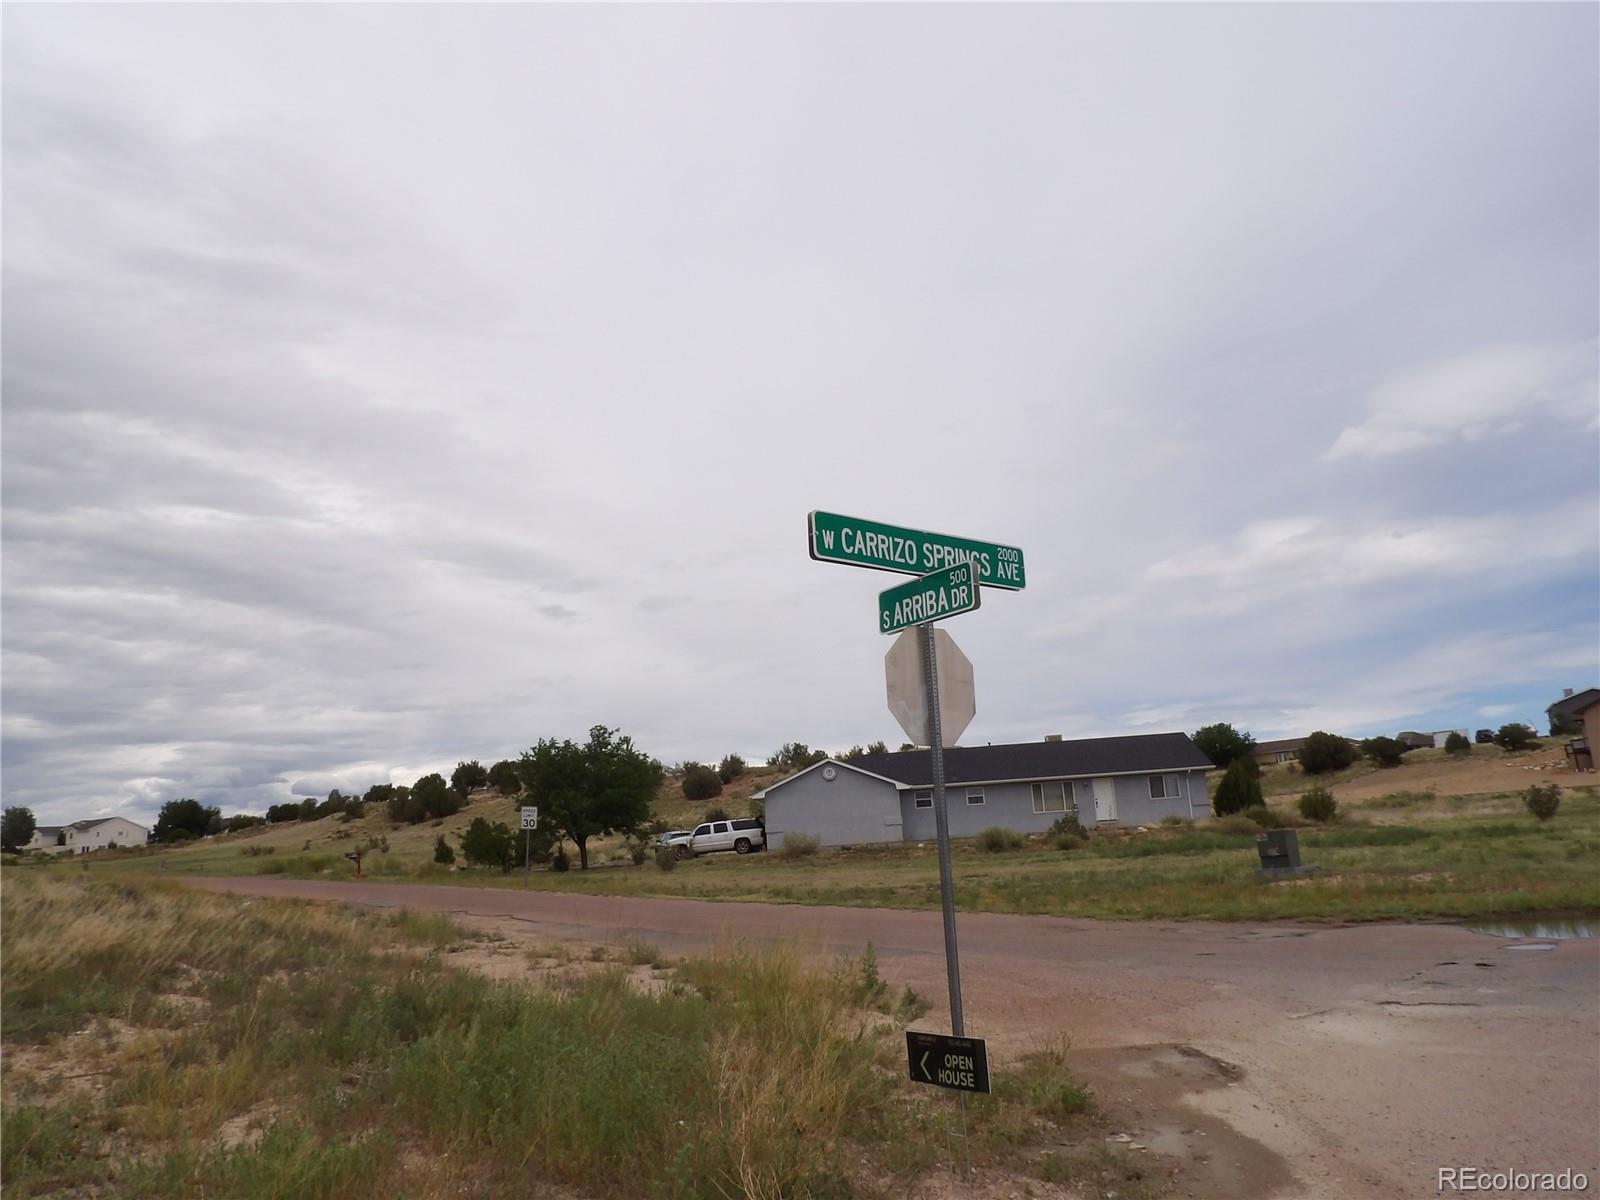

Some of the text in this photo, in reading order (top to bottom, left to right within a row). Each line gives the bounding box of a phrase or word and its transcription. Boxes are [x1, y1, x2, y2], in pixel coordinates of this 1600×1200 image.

[821, 529, 834, 550] W
[841, 527, 917, 565] CARRIZO
[997, 547, 1019, 562] 2000
[949, 567, 967, 586] 500
[996, 561, 1021, 582] AVE
[883, 585, 969, 629] S ARRIBA DR
[523, 819, 535, 828] 30
[944, 1054, 974, 1071] OPEN
[938, 1068, 975, 1088] HOUSE
